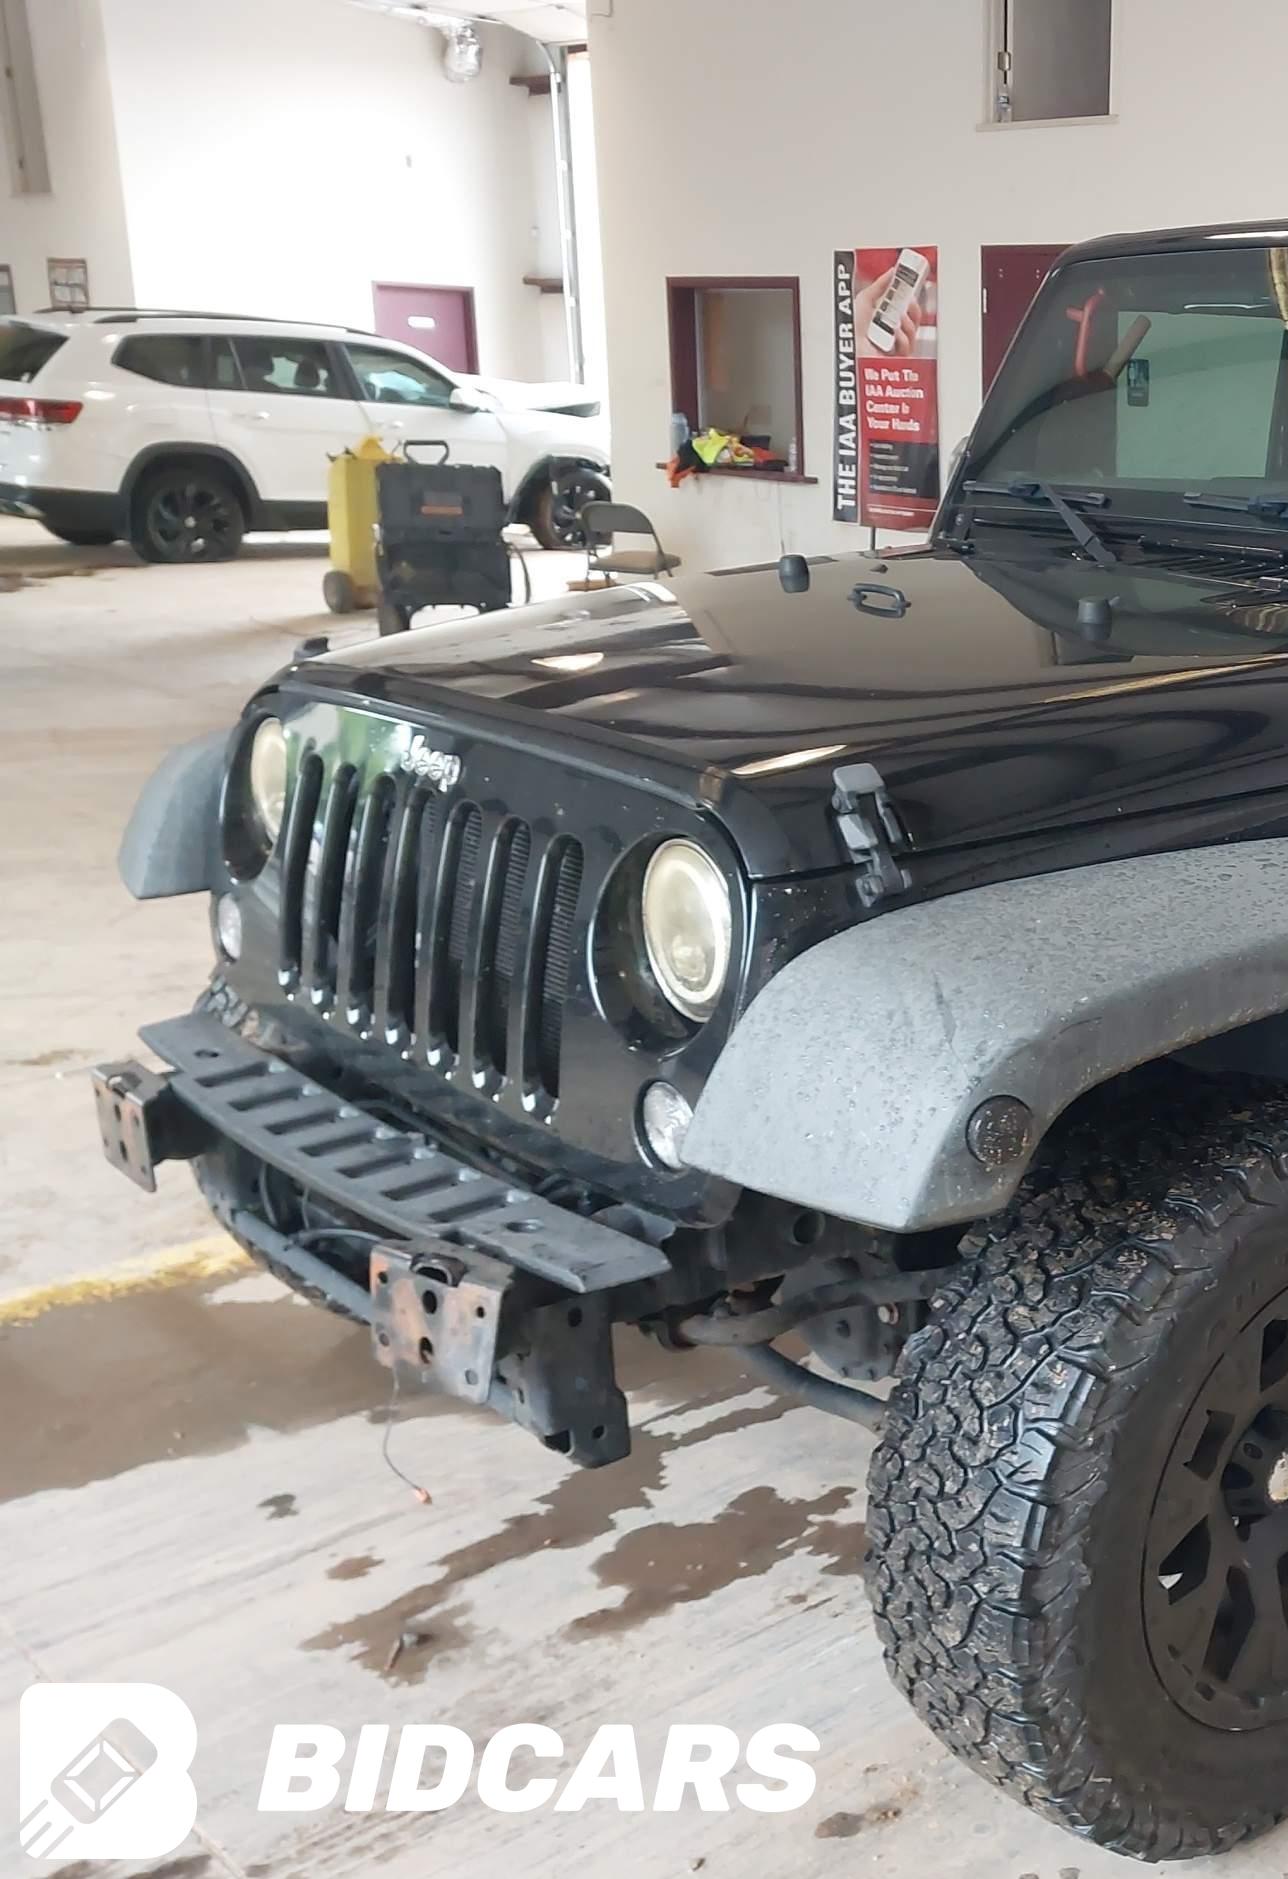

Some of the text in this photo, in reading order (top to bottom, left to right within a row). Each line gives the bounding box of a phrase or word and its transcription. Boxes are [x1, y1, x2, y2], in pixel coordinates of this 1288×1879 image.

[837, 264, 856, 510] THE IAA BUYER APP
[881, 368, 900, 382] Put
[400, 735, 462, 793] Jeep
